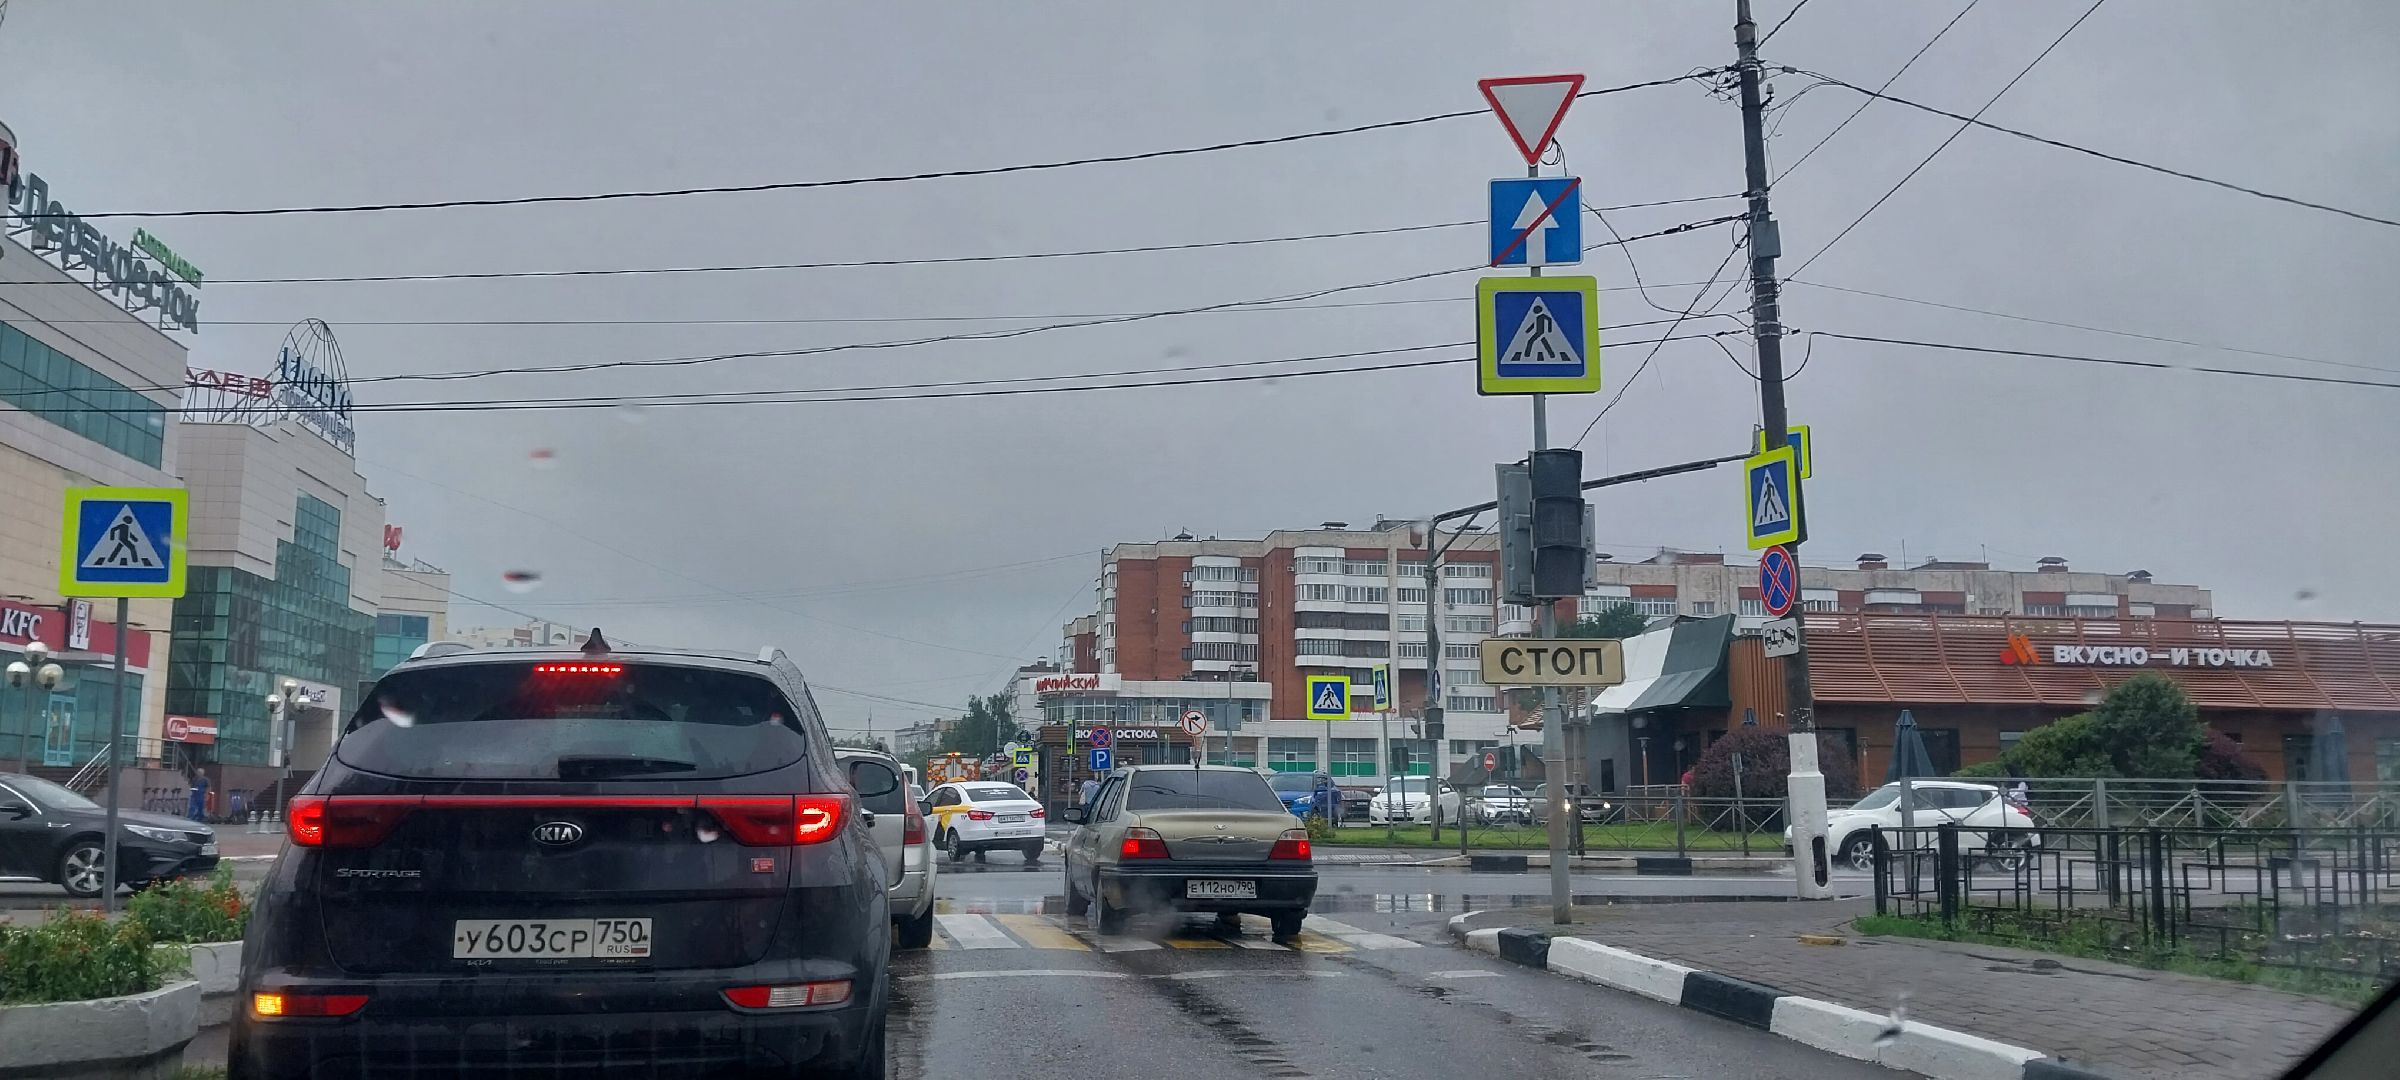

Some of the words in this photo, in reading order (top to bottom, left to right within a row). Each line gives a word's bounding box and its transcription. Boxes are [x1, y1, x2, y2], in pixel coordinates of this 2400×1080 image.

[25, 171, 200, 335] Перекресток
[0, 607, 42, 641] KFC
[1500, 647, 1603, 676] СТОП
[2193, 648, 2273, 667] ТОЧКА
[1096, 751, 1107, 768] P
[540, 827, 574, 841] KIA
[597, 920, 643, 944] 750
[606, 945, 631, 954] RUS
